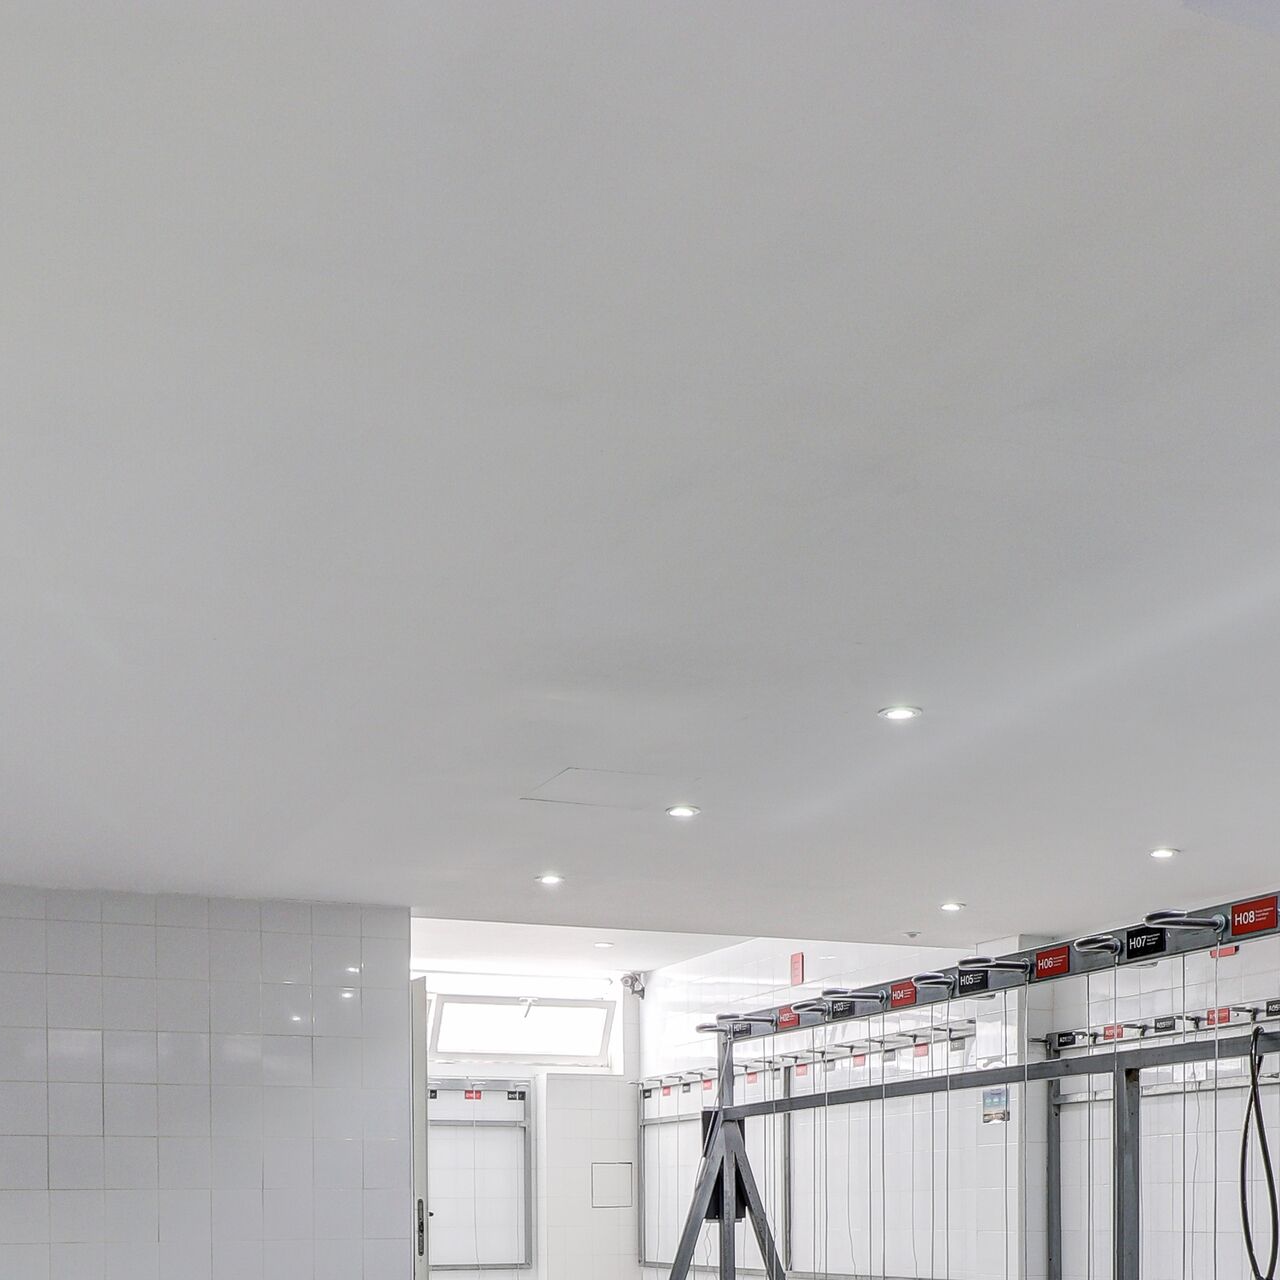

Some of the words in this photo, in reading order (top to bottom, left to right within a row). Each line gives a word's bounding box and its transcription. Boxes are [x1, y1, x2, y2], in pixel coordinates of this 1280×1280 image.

[1234, 910, 1255, 926] H08
[1129, 935, 1147, 950] H07
[1038, 957, 1054, 970] H06
[960, 974, 974, 986] H05
